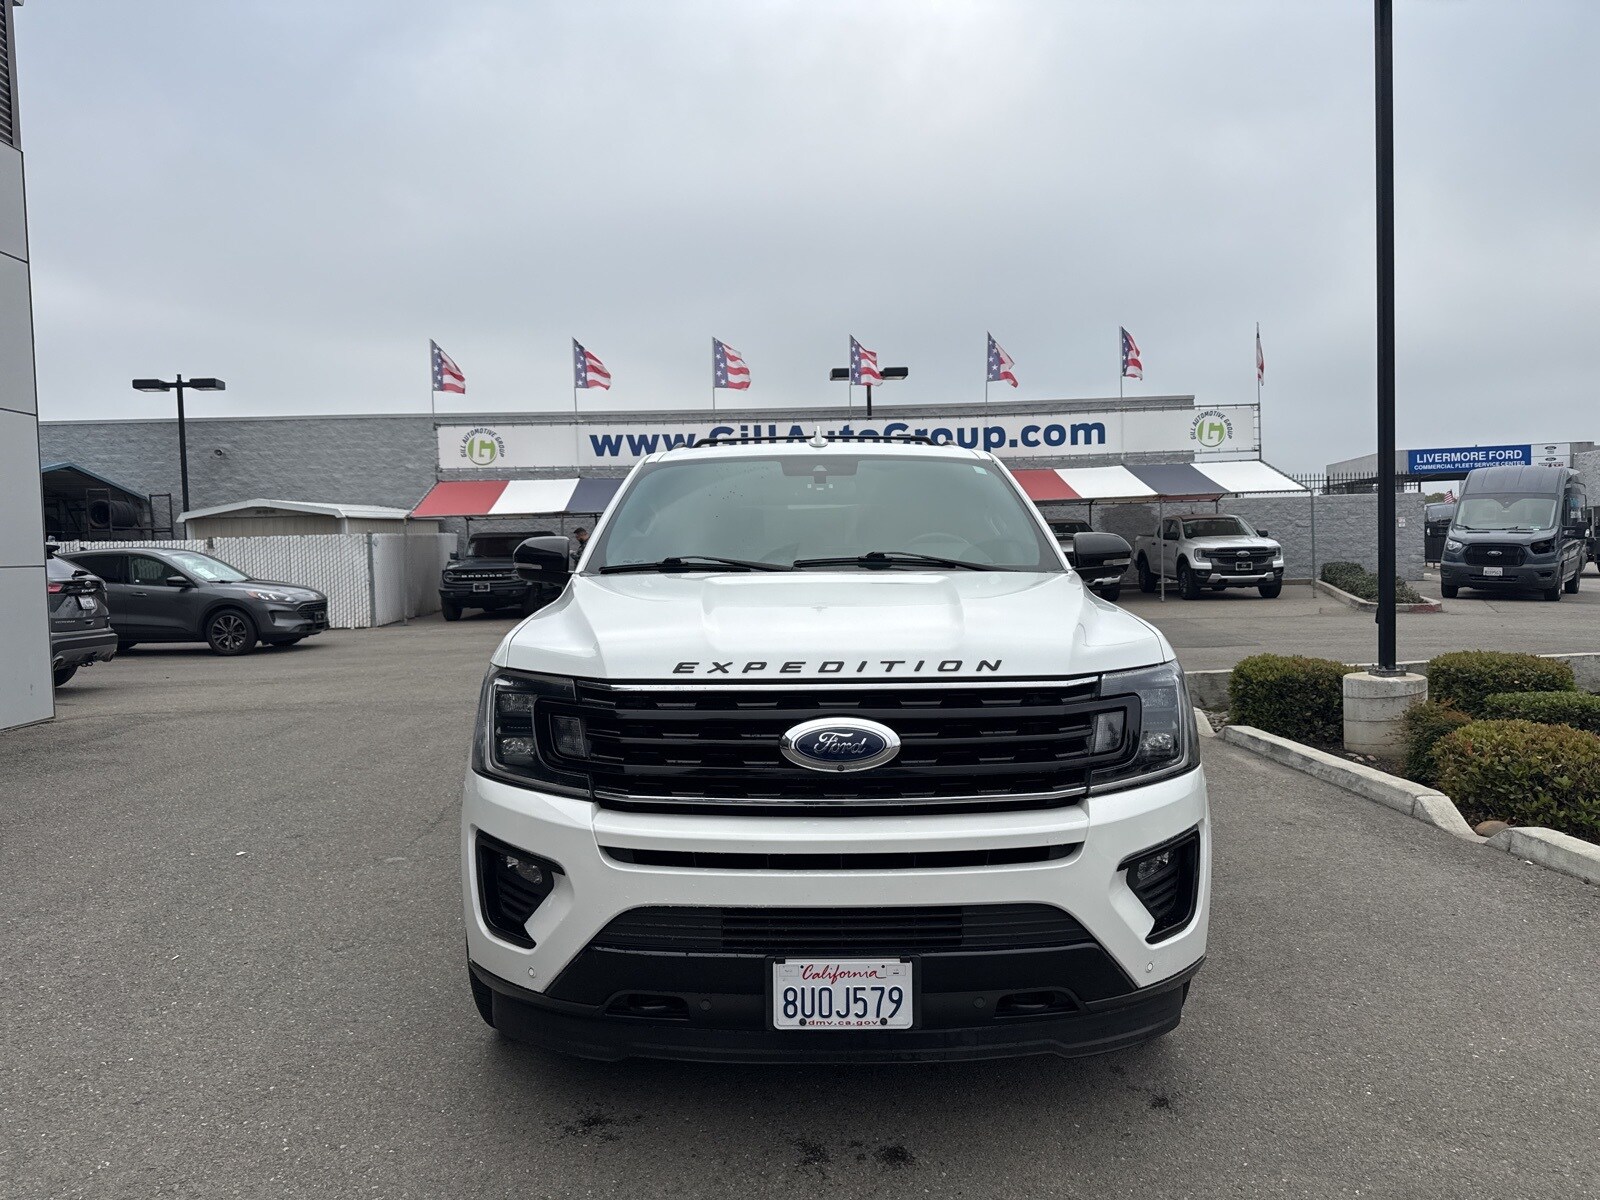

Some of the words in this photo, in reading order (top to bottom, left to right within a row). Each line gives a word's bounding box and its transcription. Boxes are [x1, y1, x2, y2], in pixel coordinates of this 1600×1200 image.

[1192, 411, 1226, 427] AUTOMOTIVE
[1223, 418, 1233, 440] GROUP
[462, 428, 497, 444] AUTOMOTIVE
[495, 436, 506, 458] GROUP
[589, 421, 1106, 457] wwwGillAtGroup.com
[1414, 463, 1454, 471] COMMERCIAL
[1416, 451, 1487, 464] LIVERMORE
[1489, 449, 1523, 461] FORD
[672, 659, 1002, 675] EXPEDITION
[813, 731, 867, 754] Ford
[802, 964, 887, 985] California
